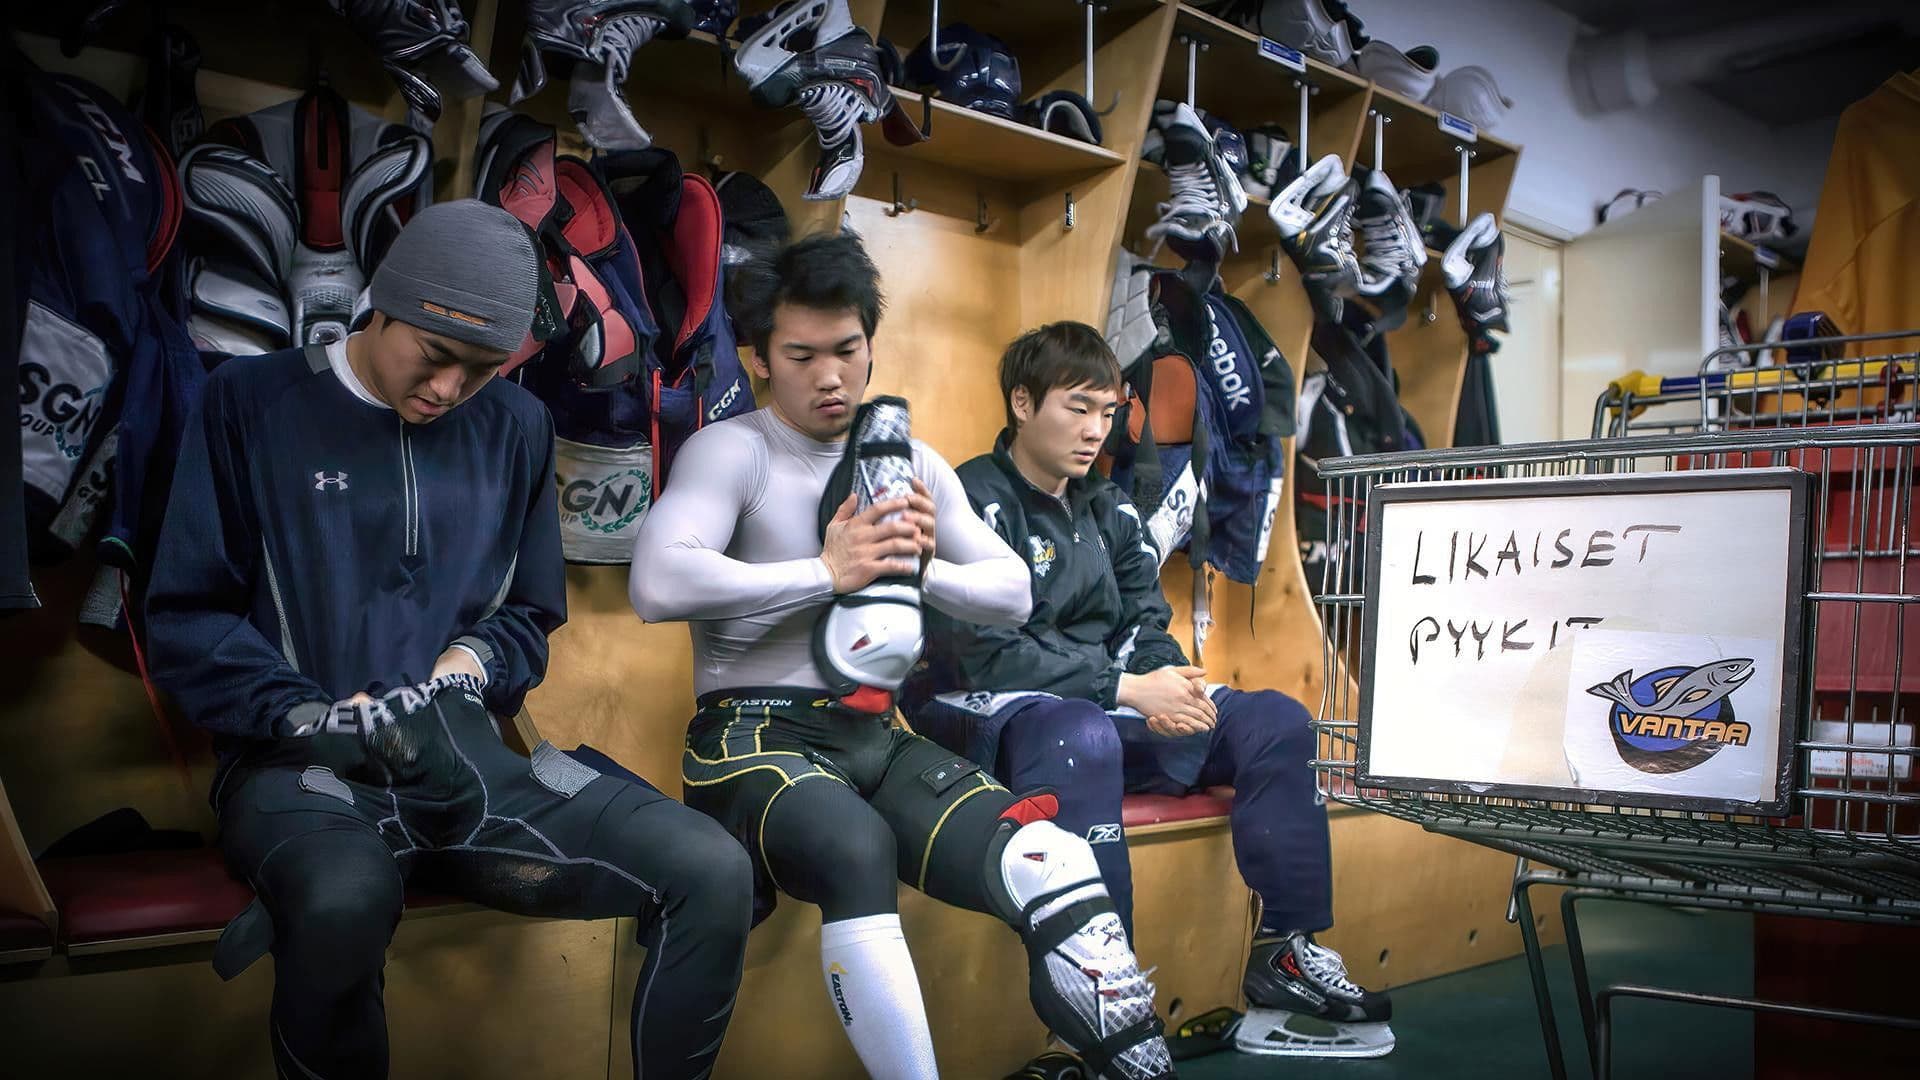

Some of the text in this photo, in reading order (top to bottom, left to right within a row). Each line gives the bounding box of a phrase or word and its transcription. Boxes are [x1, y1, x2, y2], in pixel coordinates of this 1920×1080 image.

[20, 414, 57, 436] OUP
[562, 479, 634, 516] GN
[1412, 524, 1682, 585] LIKAISET
[1617, 711, 1751, 746] VANTAA
[832, 973, 853, 1022] EASTON
